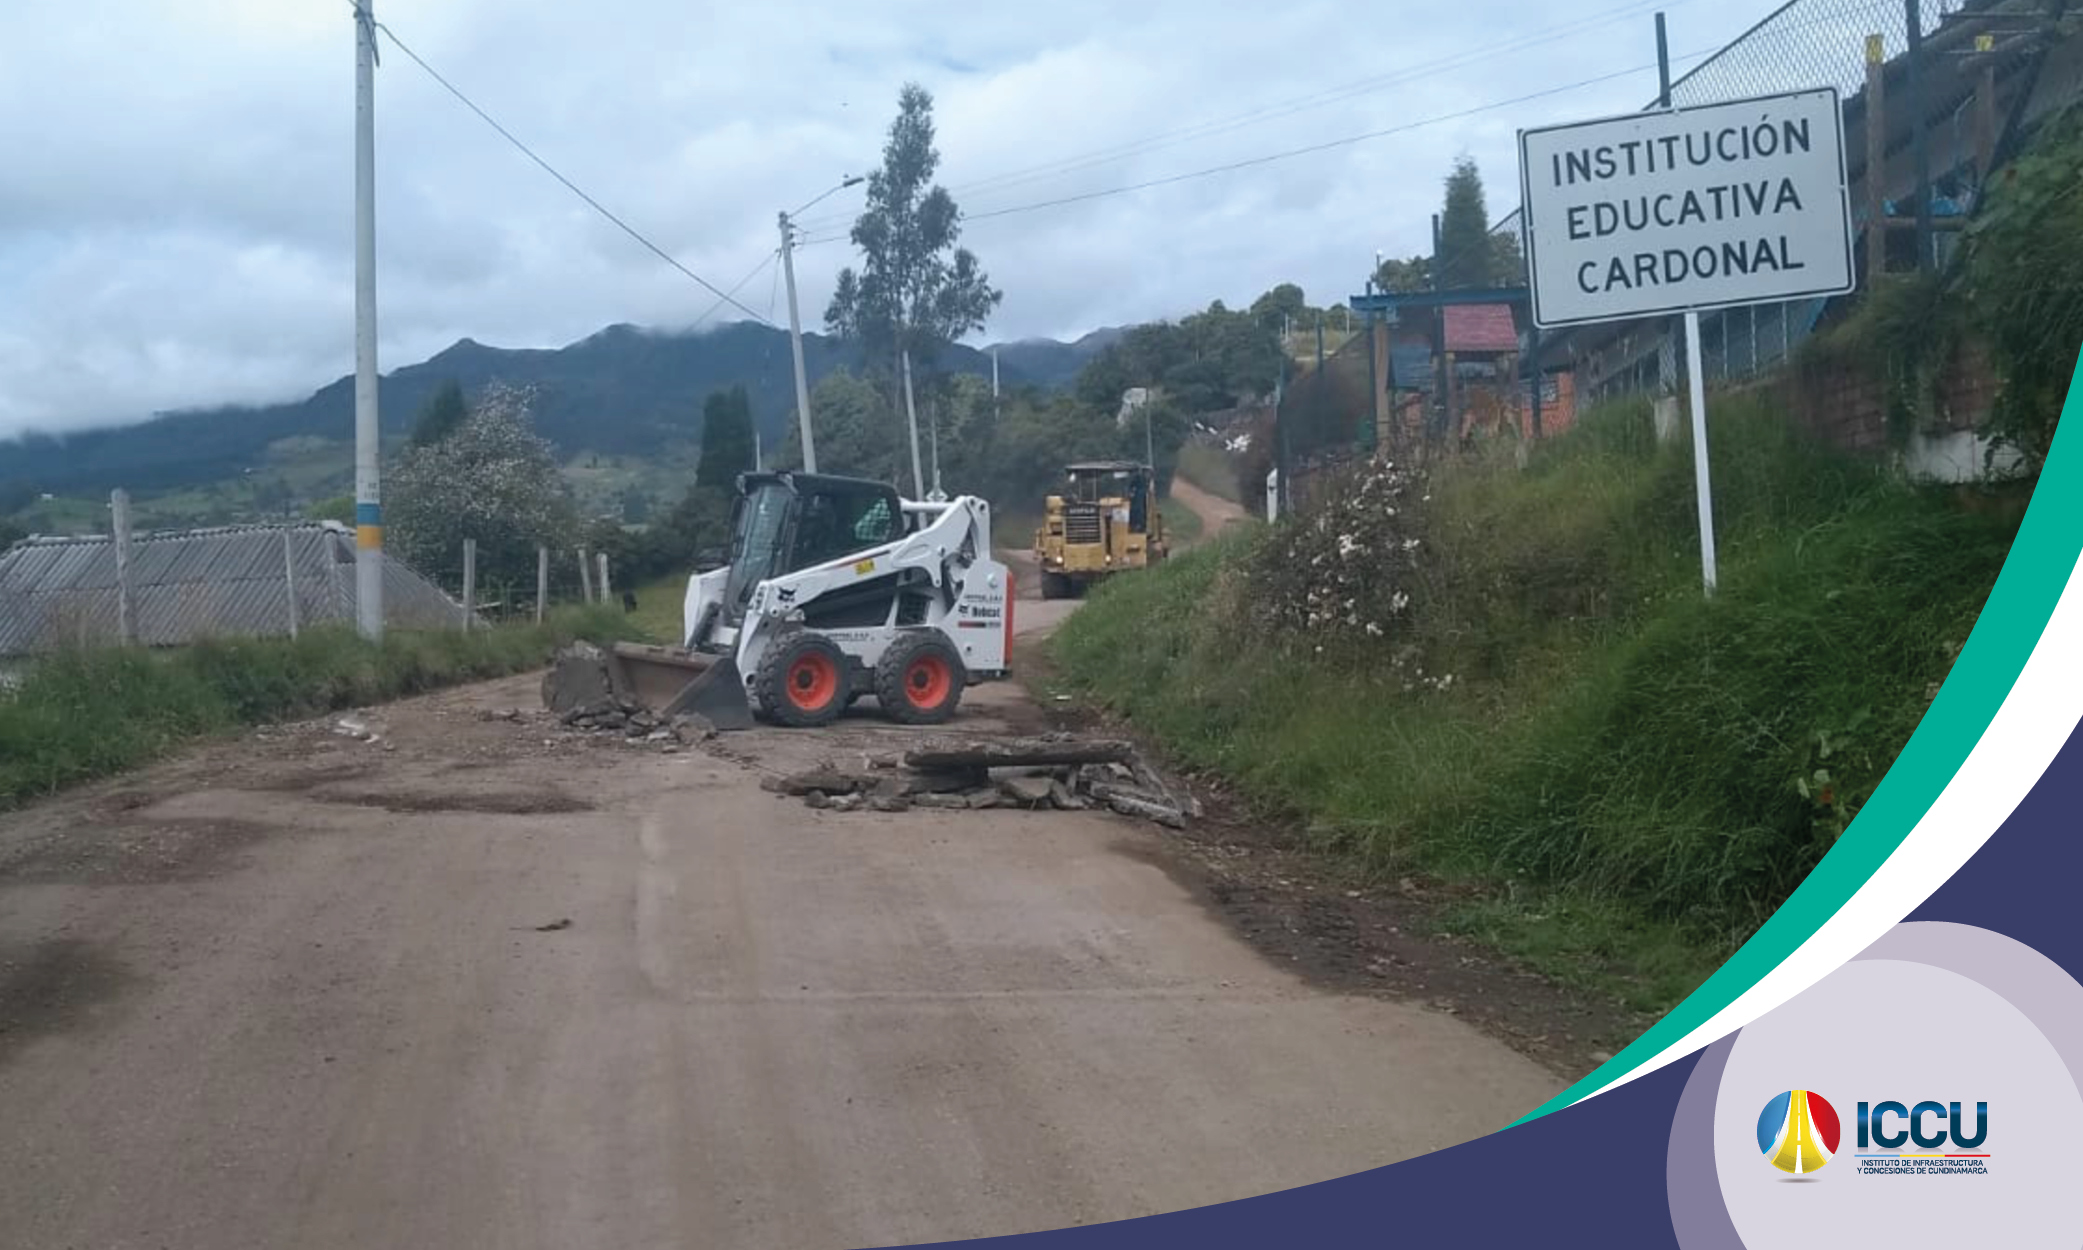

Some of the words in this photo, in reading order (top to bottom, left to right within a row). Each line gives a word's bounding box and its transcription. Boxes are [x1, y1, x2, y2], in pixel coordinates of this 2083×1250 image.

[1553, 114, 1810, 187] INSTITUCIÓN
[1567, 177, 1802, 241] EDUCATIVA
[1577, 236, 1805, 294] CARDONAL
